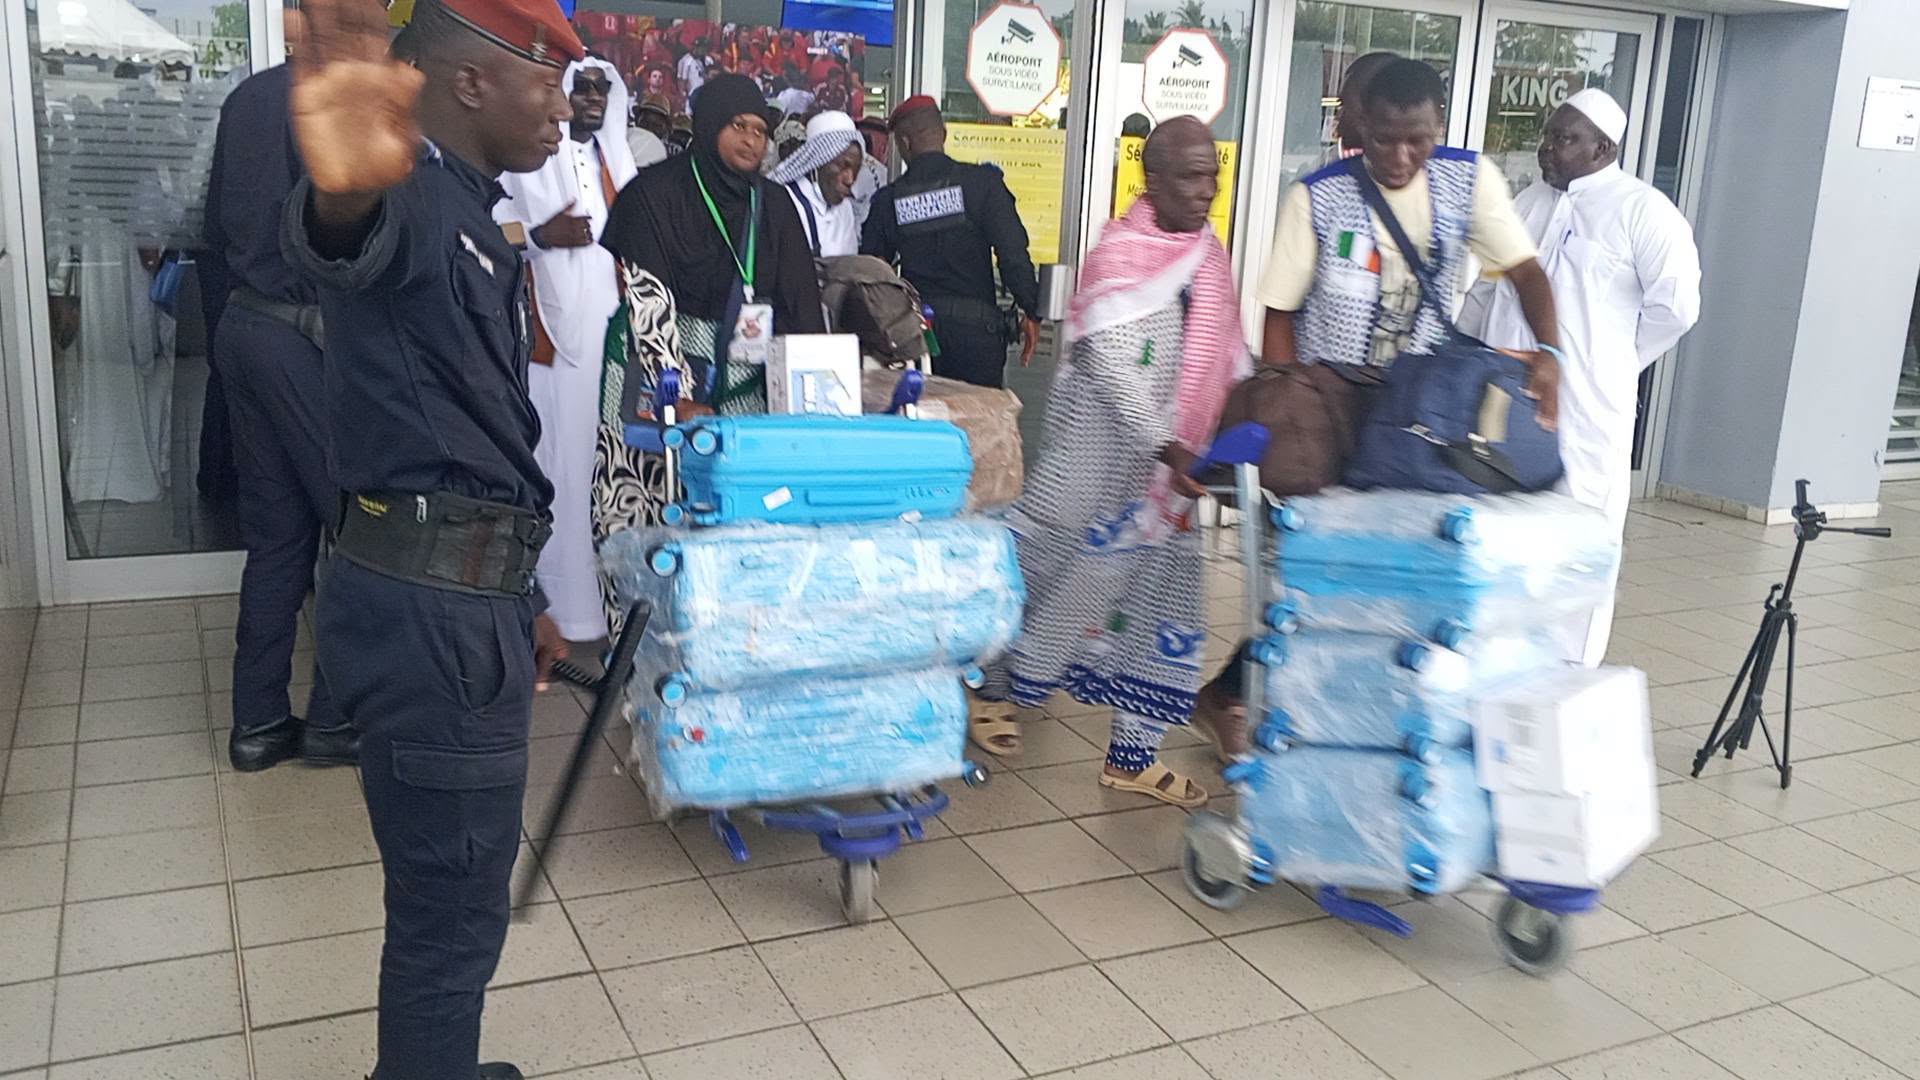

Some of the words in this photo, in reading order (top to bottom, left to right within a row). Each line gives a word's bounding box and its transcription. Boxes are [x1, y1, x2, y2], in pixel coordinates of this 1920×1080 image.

[986, 51, 1043, 68] AÉROPORT
[988, 65, 1013, 77] SOUS
[1014, 68, 1040, 80] VIDÉO
[982, 77, 1043, 93] SURVEILLANCE
[1159, 76, 1210, 89] AÉROPORT
[1161, 89, 1183, 99] SOUS
[1501, 75, 1569, 109] KING
[1155, 101, 1210, 113] SURVEILLANCE
